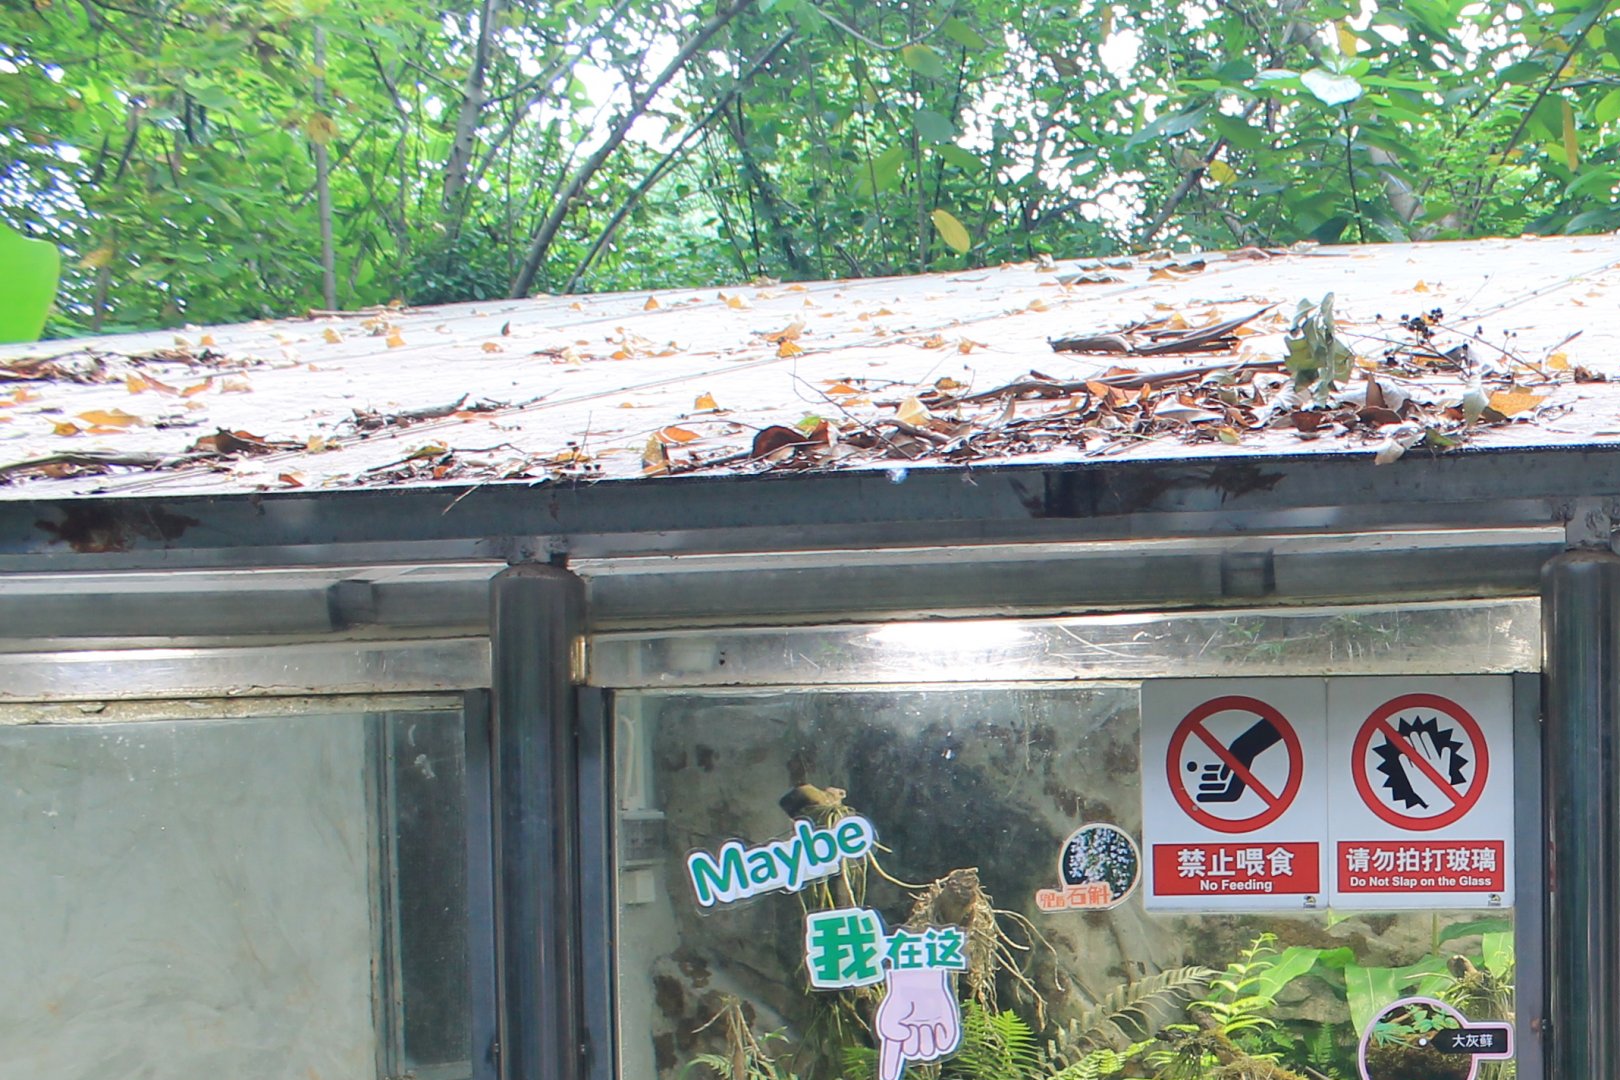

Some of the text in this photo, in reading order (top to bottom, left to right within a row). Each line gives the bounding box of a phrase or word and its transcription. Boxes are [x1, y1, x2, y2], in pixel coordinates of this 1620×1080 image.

[692, 821, 865, 902] Maybe
[1177, 847, 1294, 877] 禁止喂食
[1346, 847, 1496, 872] 请勿拍打玻璃
[1200, 879, 1273, 892] No Feeding
[1350, 876, 1492, 888] Do Not Slap on the Glass
[812, 915, 965, 981] 我在这
[1452, 1034, 1493, 1048] 大灰藓
